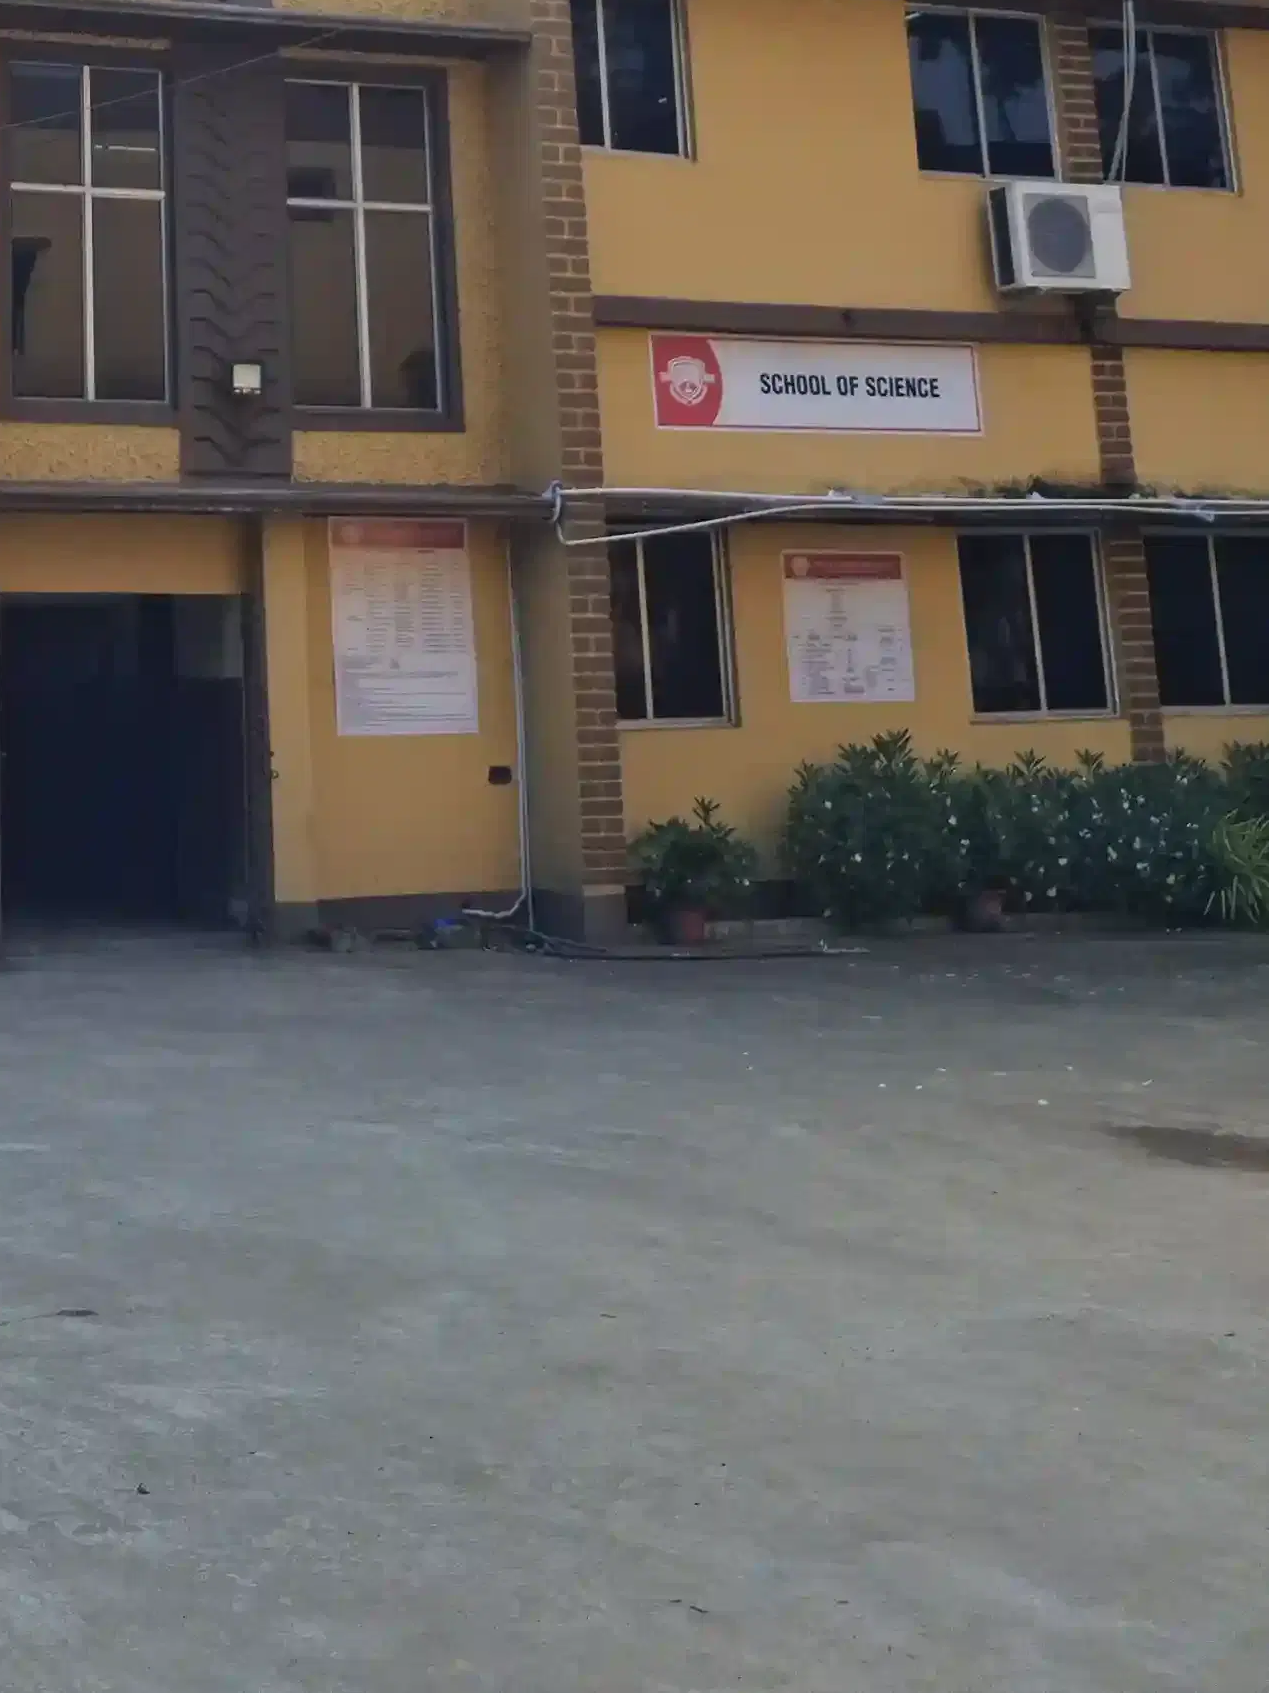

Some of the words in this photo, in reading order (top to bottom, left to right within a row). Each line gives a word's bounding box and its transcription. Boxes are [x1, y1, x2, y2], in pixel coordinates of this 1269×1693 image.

[759, 372, 832, 396] SCHOOL
[836, 375, 859, 397] OF
[865, 376, 941, 398] SCIENCE
